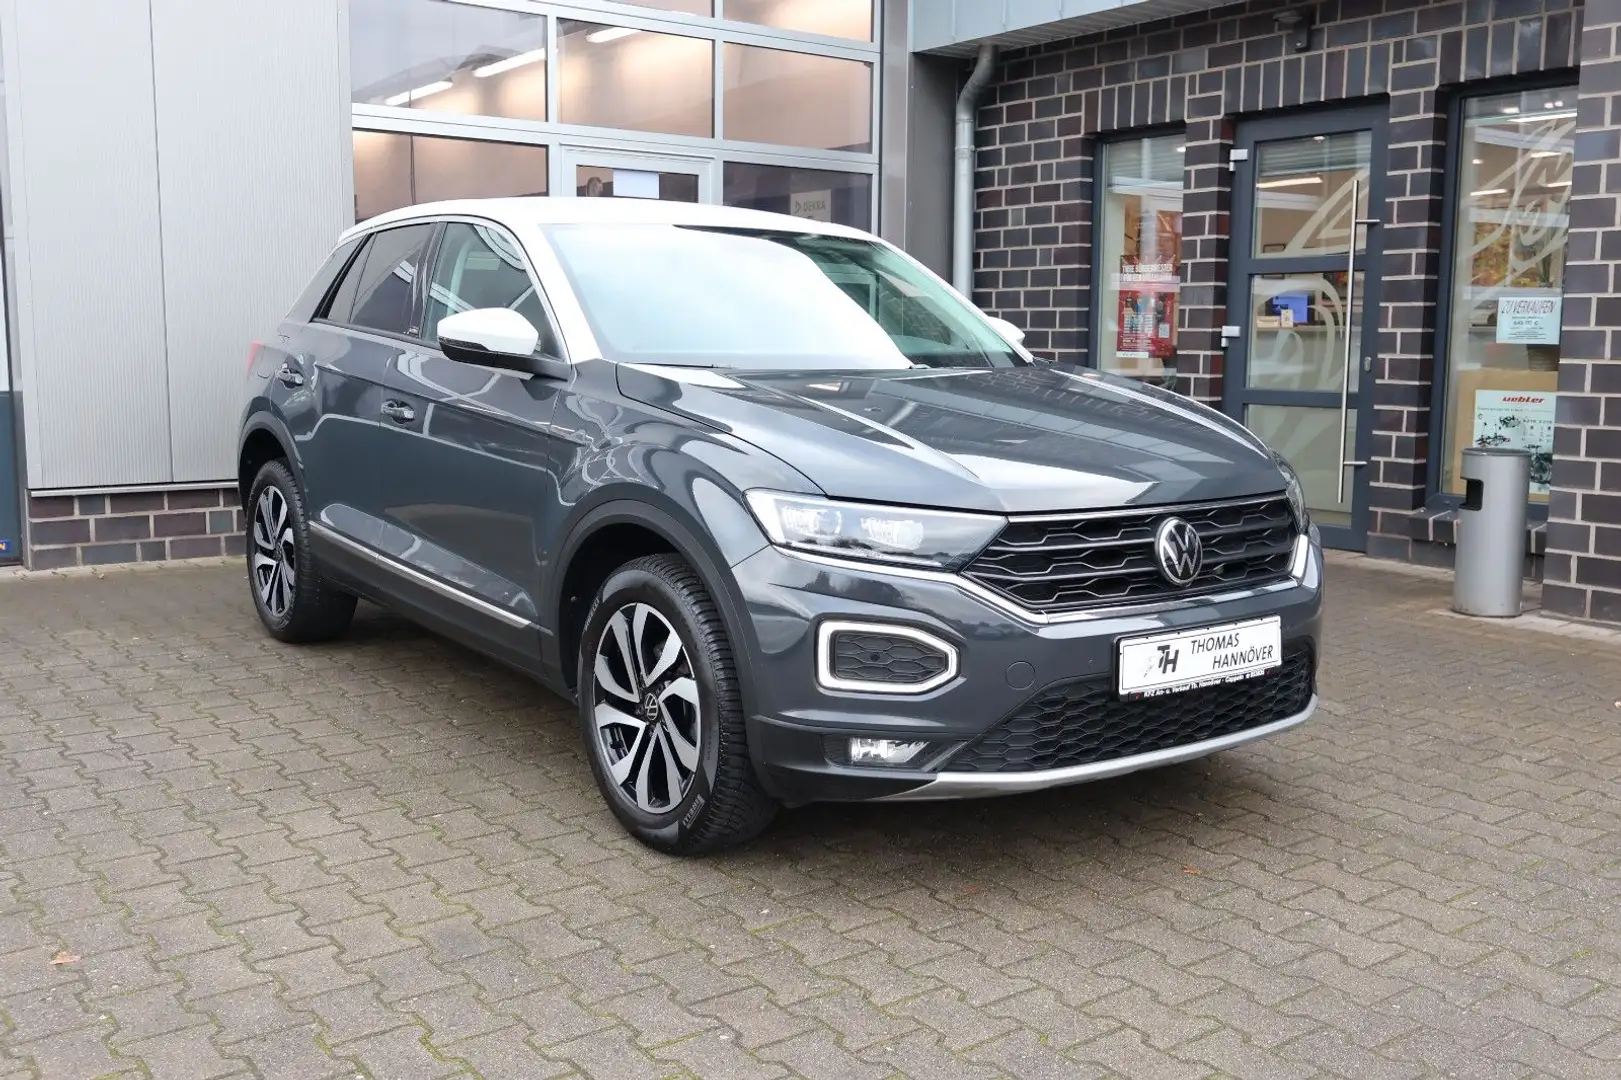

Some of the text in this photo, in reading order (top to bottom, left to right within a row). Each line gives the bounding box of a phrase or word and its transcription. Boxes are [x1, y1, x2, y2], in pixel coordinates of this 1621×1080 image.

[1513, 299, 1557, 315] VERKAUFEN
[1502, 395, 1545, 405] uebler
[1190, 632, 1240, 655] THOMAS
[1212, 644, 1274, 670] HANNÖVER
